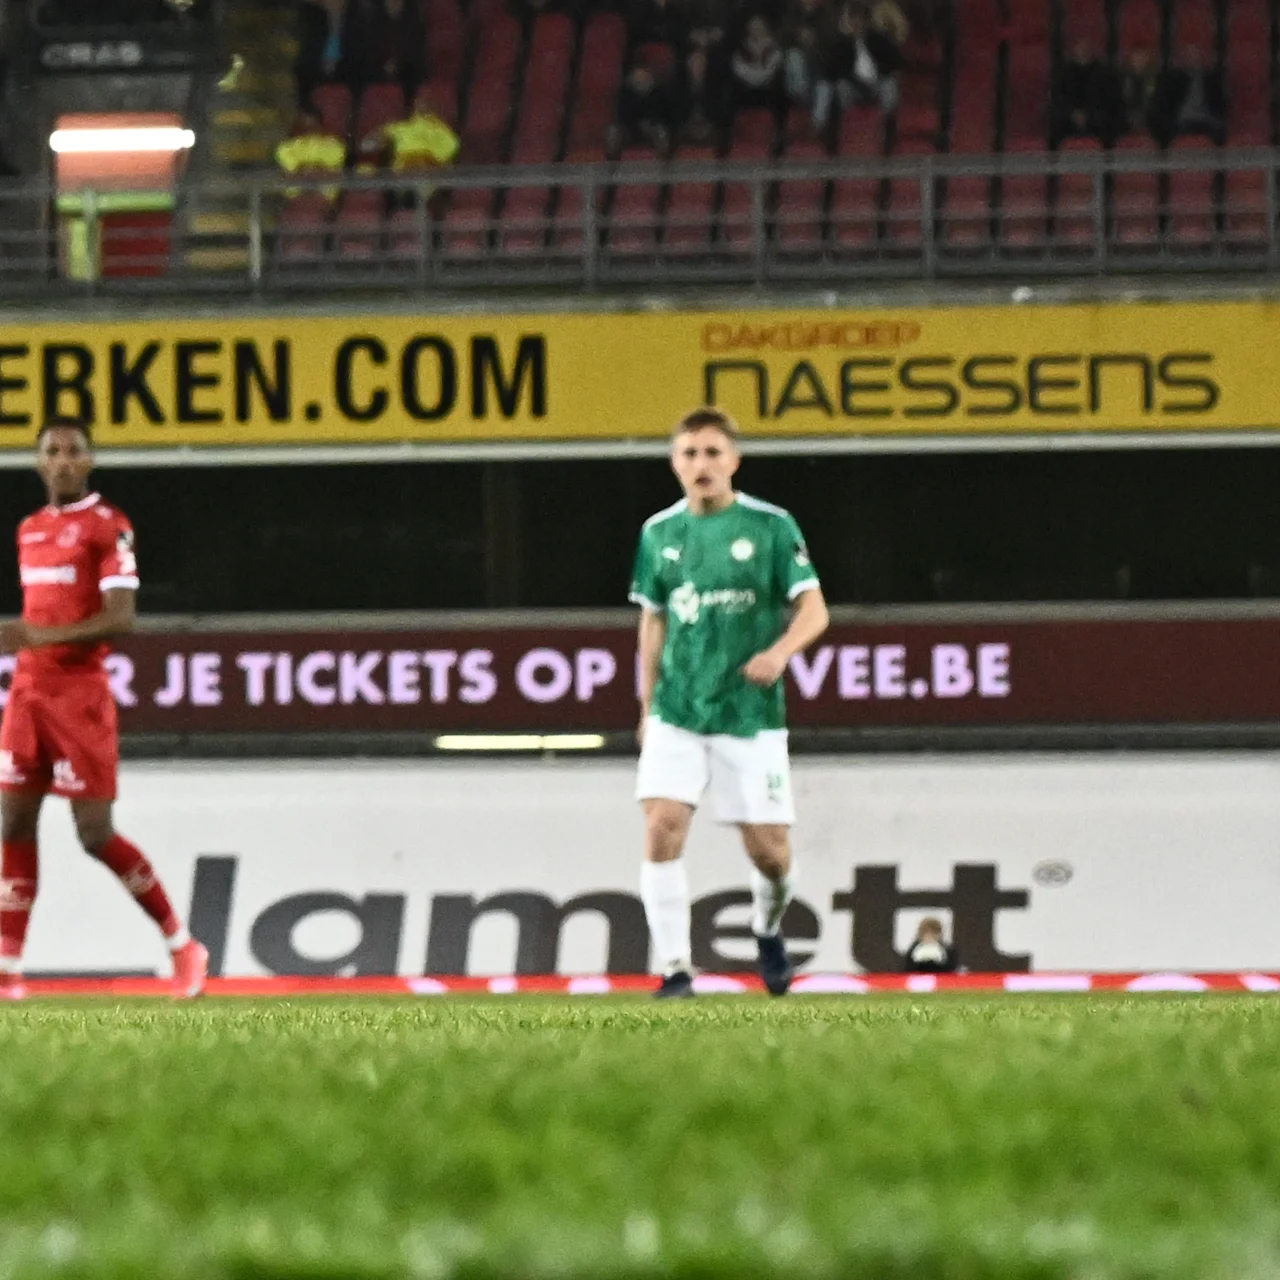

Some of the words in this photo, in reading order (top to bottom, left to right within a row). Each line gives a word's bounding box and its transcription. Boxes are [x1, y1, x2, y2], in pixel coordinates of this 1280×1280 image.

[154, 652, 222, 705] JE
[236, 649, 496, 704] TICKETS
[515, 647, 616, 702] OP
